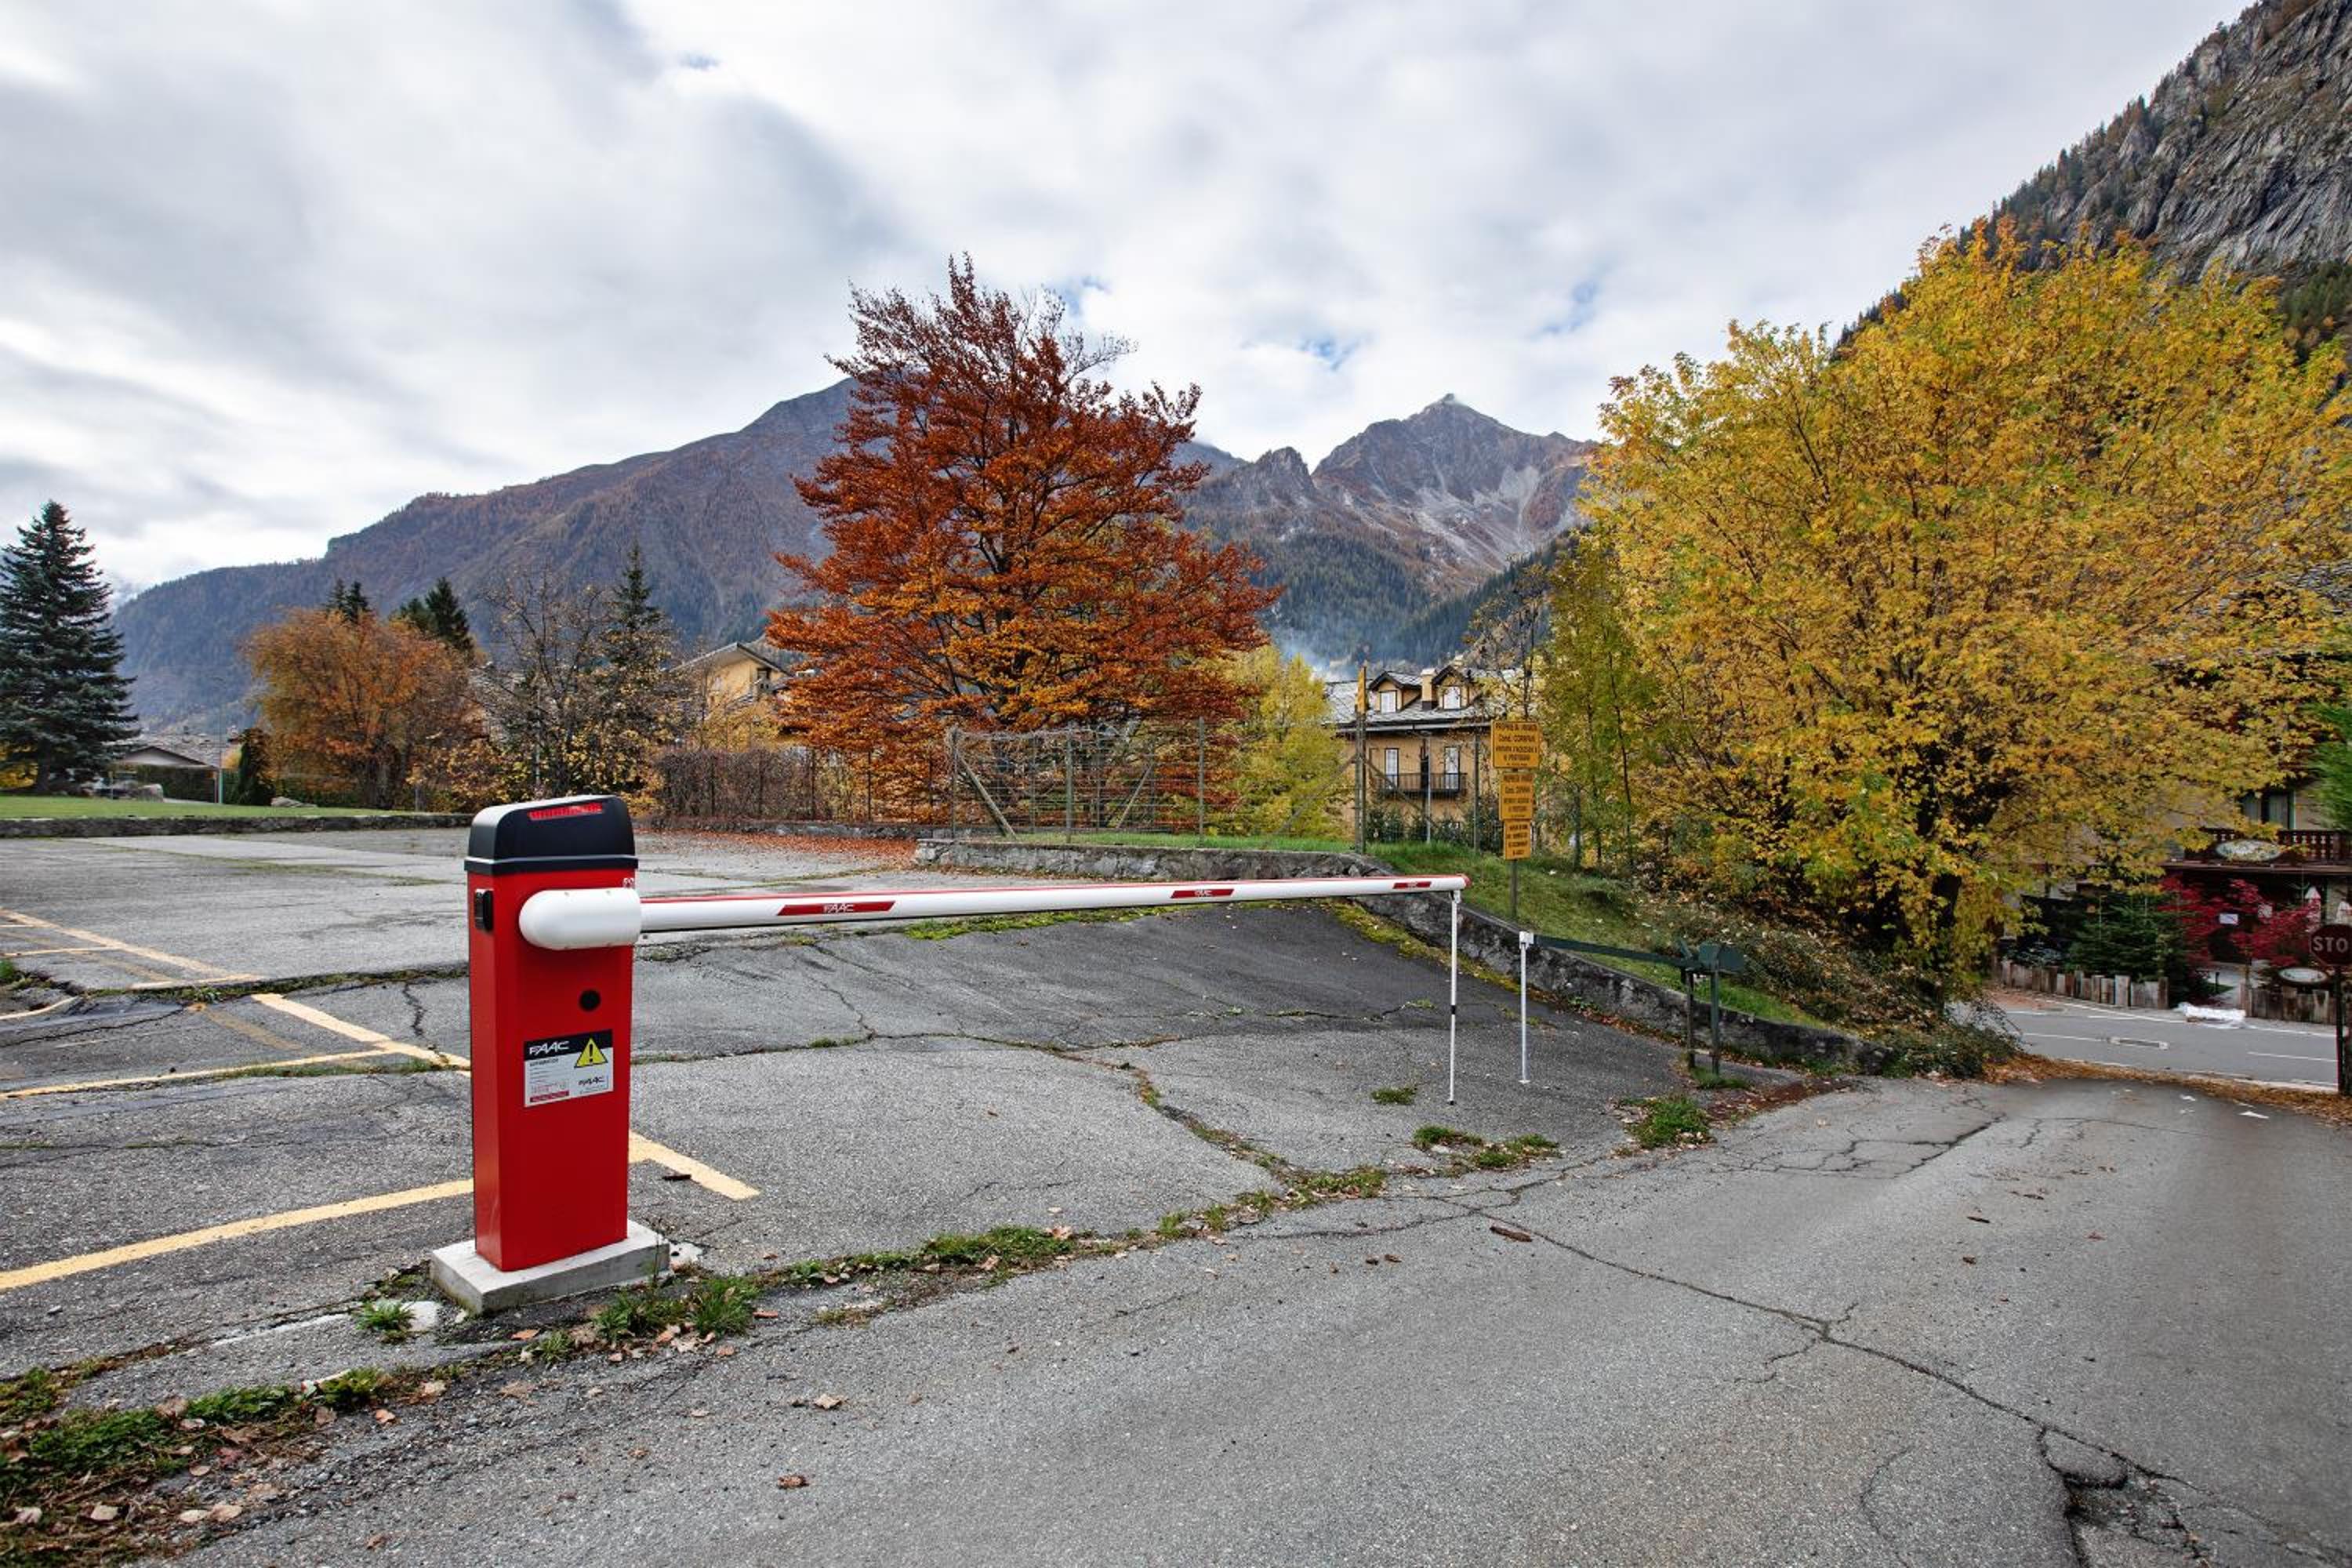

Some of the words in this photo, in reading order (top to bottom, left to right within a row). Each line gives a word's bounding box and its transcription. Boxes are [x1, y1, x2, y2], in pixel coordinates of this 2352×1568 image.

[823, 903, 854, 913] FAAC
[2313, 936, 2349, 953] STO
[529, 1040, 570, 1056] FAAC
